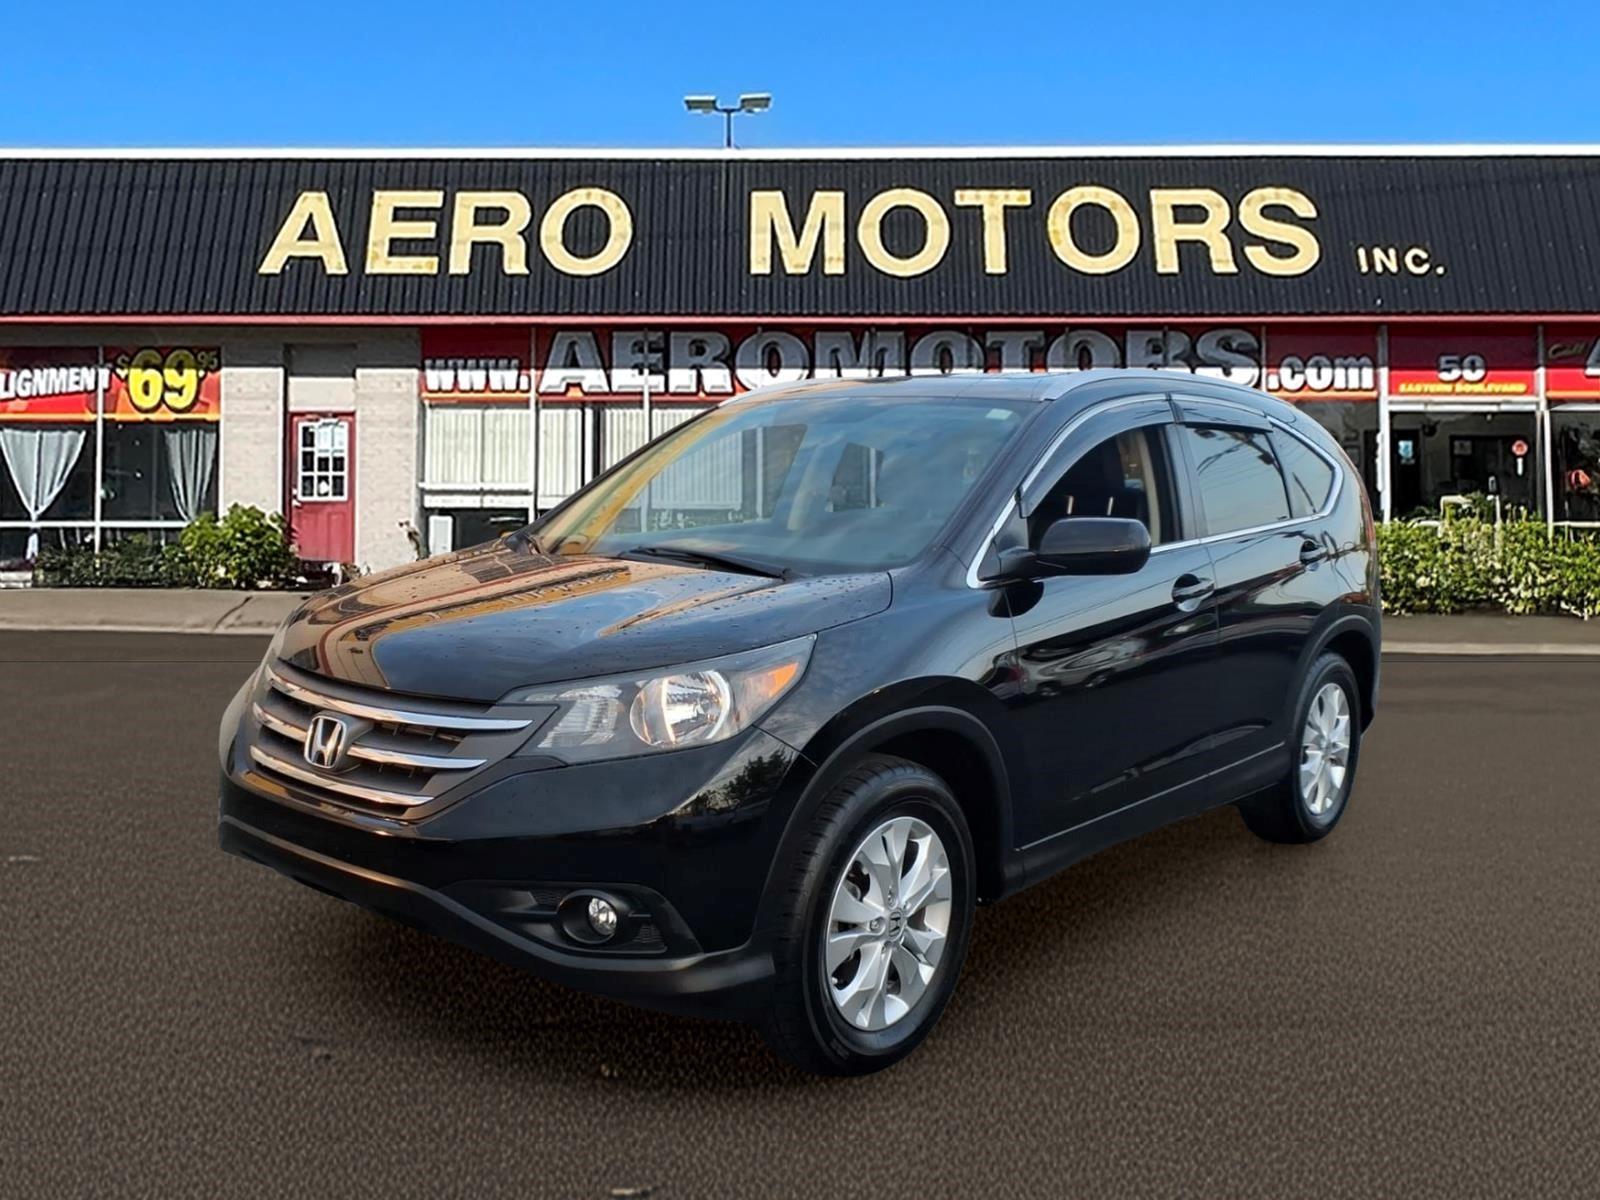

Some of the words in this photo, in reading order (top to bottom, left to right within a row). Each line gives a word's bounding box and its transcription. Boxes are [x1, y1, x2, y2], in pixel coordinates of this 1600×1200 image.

[258, 187, 634, 277] AERO
[749, 187, 1321, 278] MOTORS
[1357, 246, 1445, 275] INC.
[1437, 353, 1486, 383] 50
